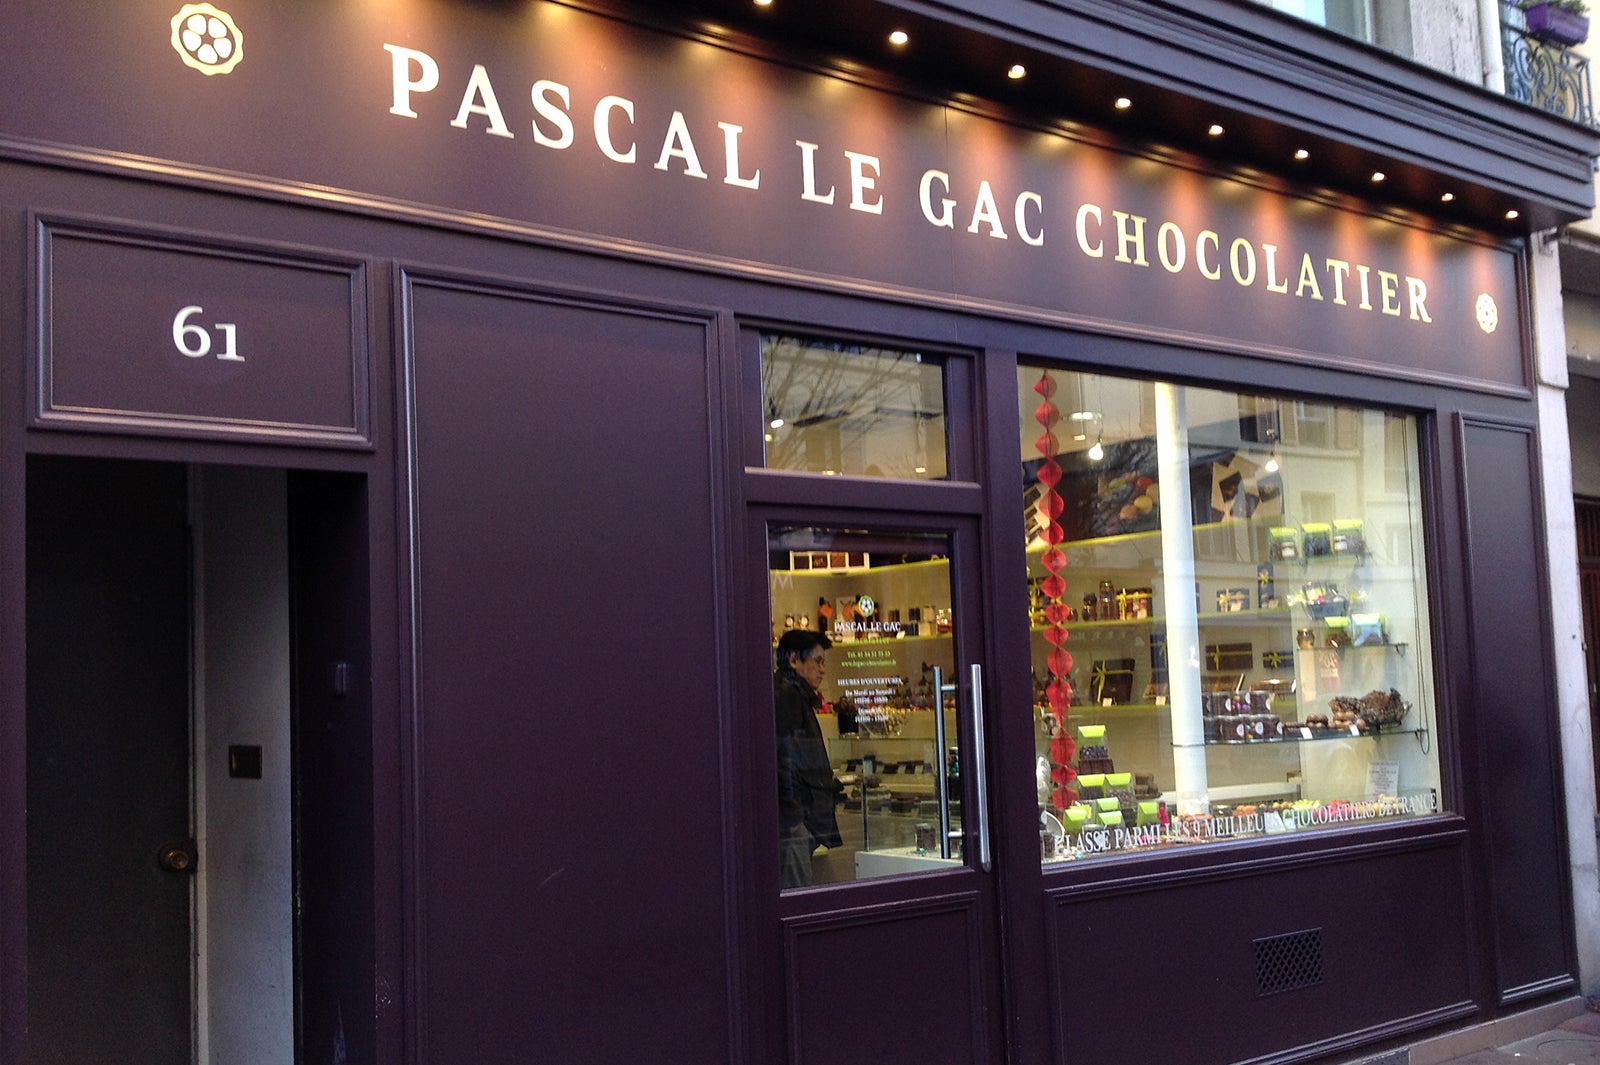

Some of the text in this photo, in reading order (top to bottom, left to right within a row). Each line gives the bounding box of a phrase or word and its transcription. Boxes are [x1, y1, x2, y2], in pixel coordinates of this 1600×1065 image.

[382, 43, 1433, 324] PASCAL LE GAC CHOCOLATIER
[172, 305, 246, 363] 61
[834, 621, 901, 633] PASCAL LE GAC
[1114, 822, 1163, 850] PARMI
[1164, 821, 1191, 843] LES
[1193, 821, 1201, 839] 9
[1204, 809, 1281, 838] MEILLEU
[1283, 801, 1377, 830] CHOCOLATIERS
[1377, 799, 1393, 818] DE
[1393, 792, 1437, 815] FRANCE
